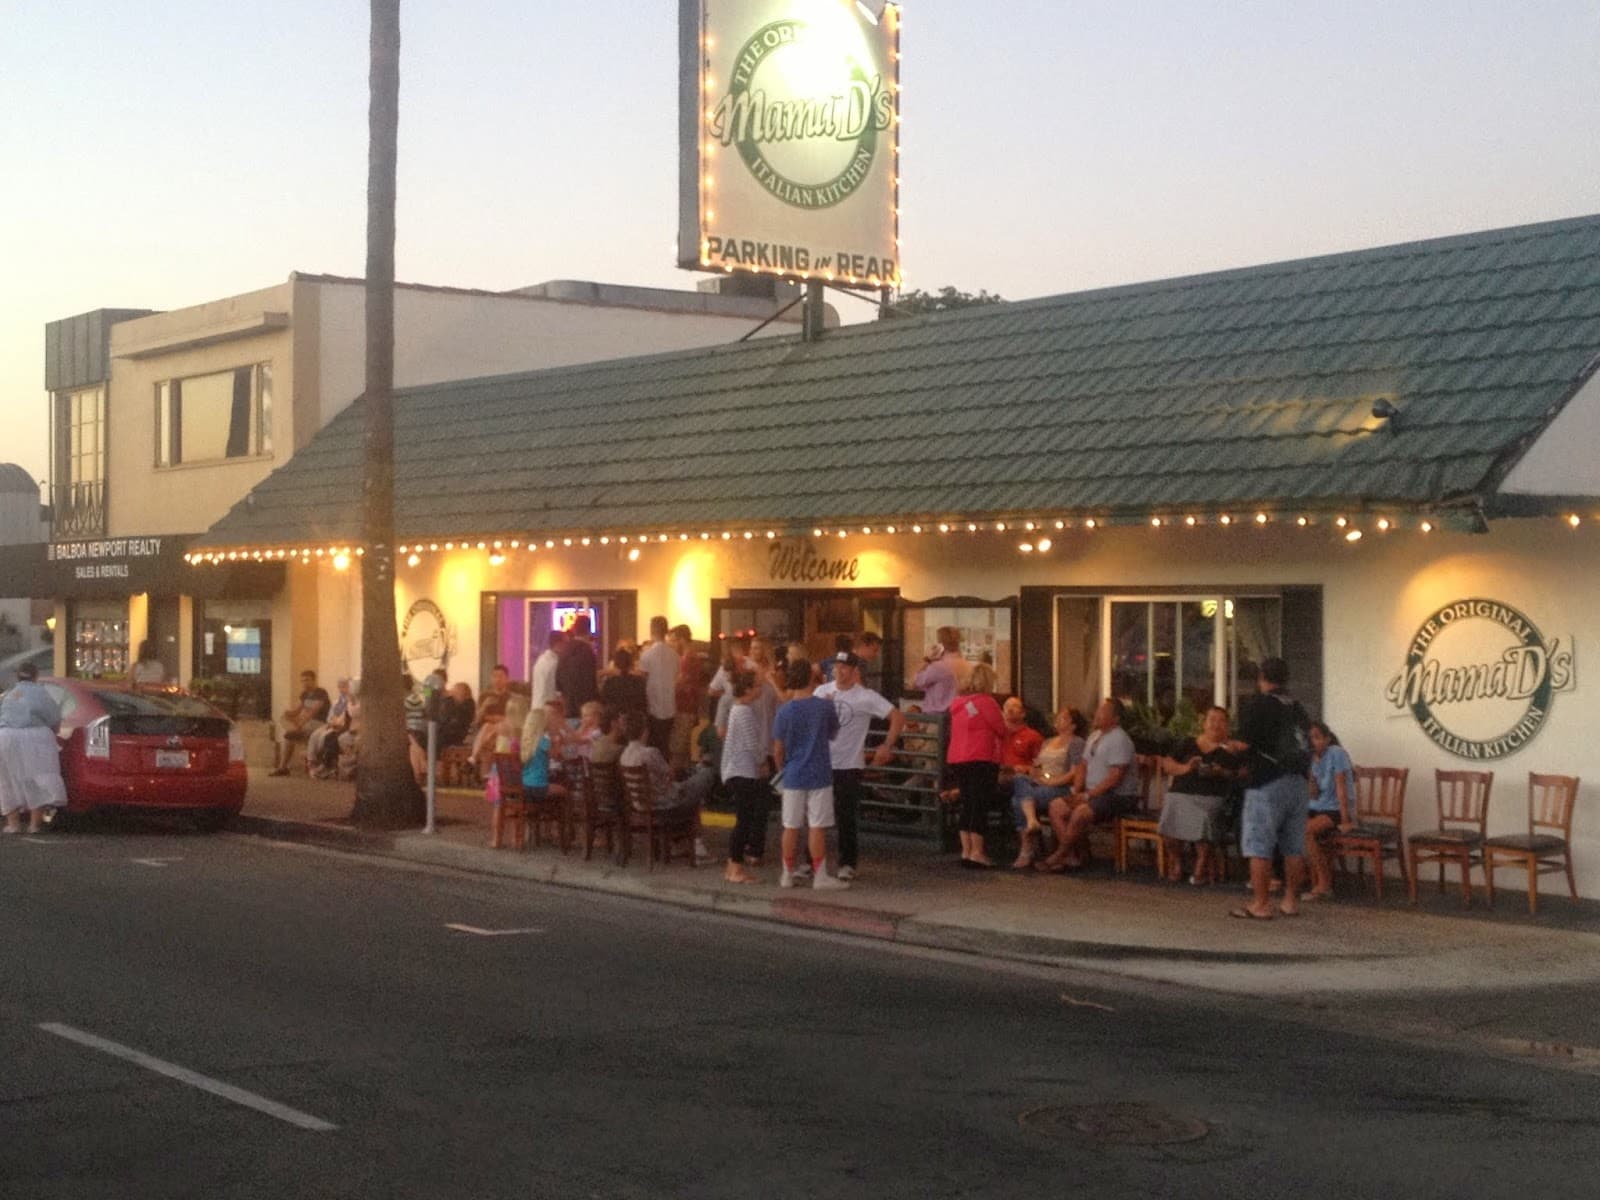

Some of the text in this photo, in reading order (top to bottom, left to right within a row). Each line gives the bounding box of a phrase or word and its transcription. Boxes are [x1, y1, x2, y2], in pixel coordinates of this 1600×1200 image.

[734, 42, 766, 85] THE
[750, 148, 872, 206] ITALIAN KITCHEN
[707, 236, 810, 271] PARKING
[836, 252, 895, 281] REAR
[56, 542, 88, 561] BALBOA
[88, 540, 127, 559] NEWPORT
[129, 538, 161, 556] REALTY
[75, 566, 95, 579] SALES
[101, 564, 129, 578] RENTALS
[768, 541, 861, 582] Welcome
[1410, 601, 1535, 657] THE ORIGINAL
[1424, 706, 1545, 759] ITALIAN KITCHEN
